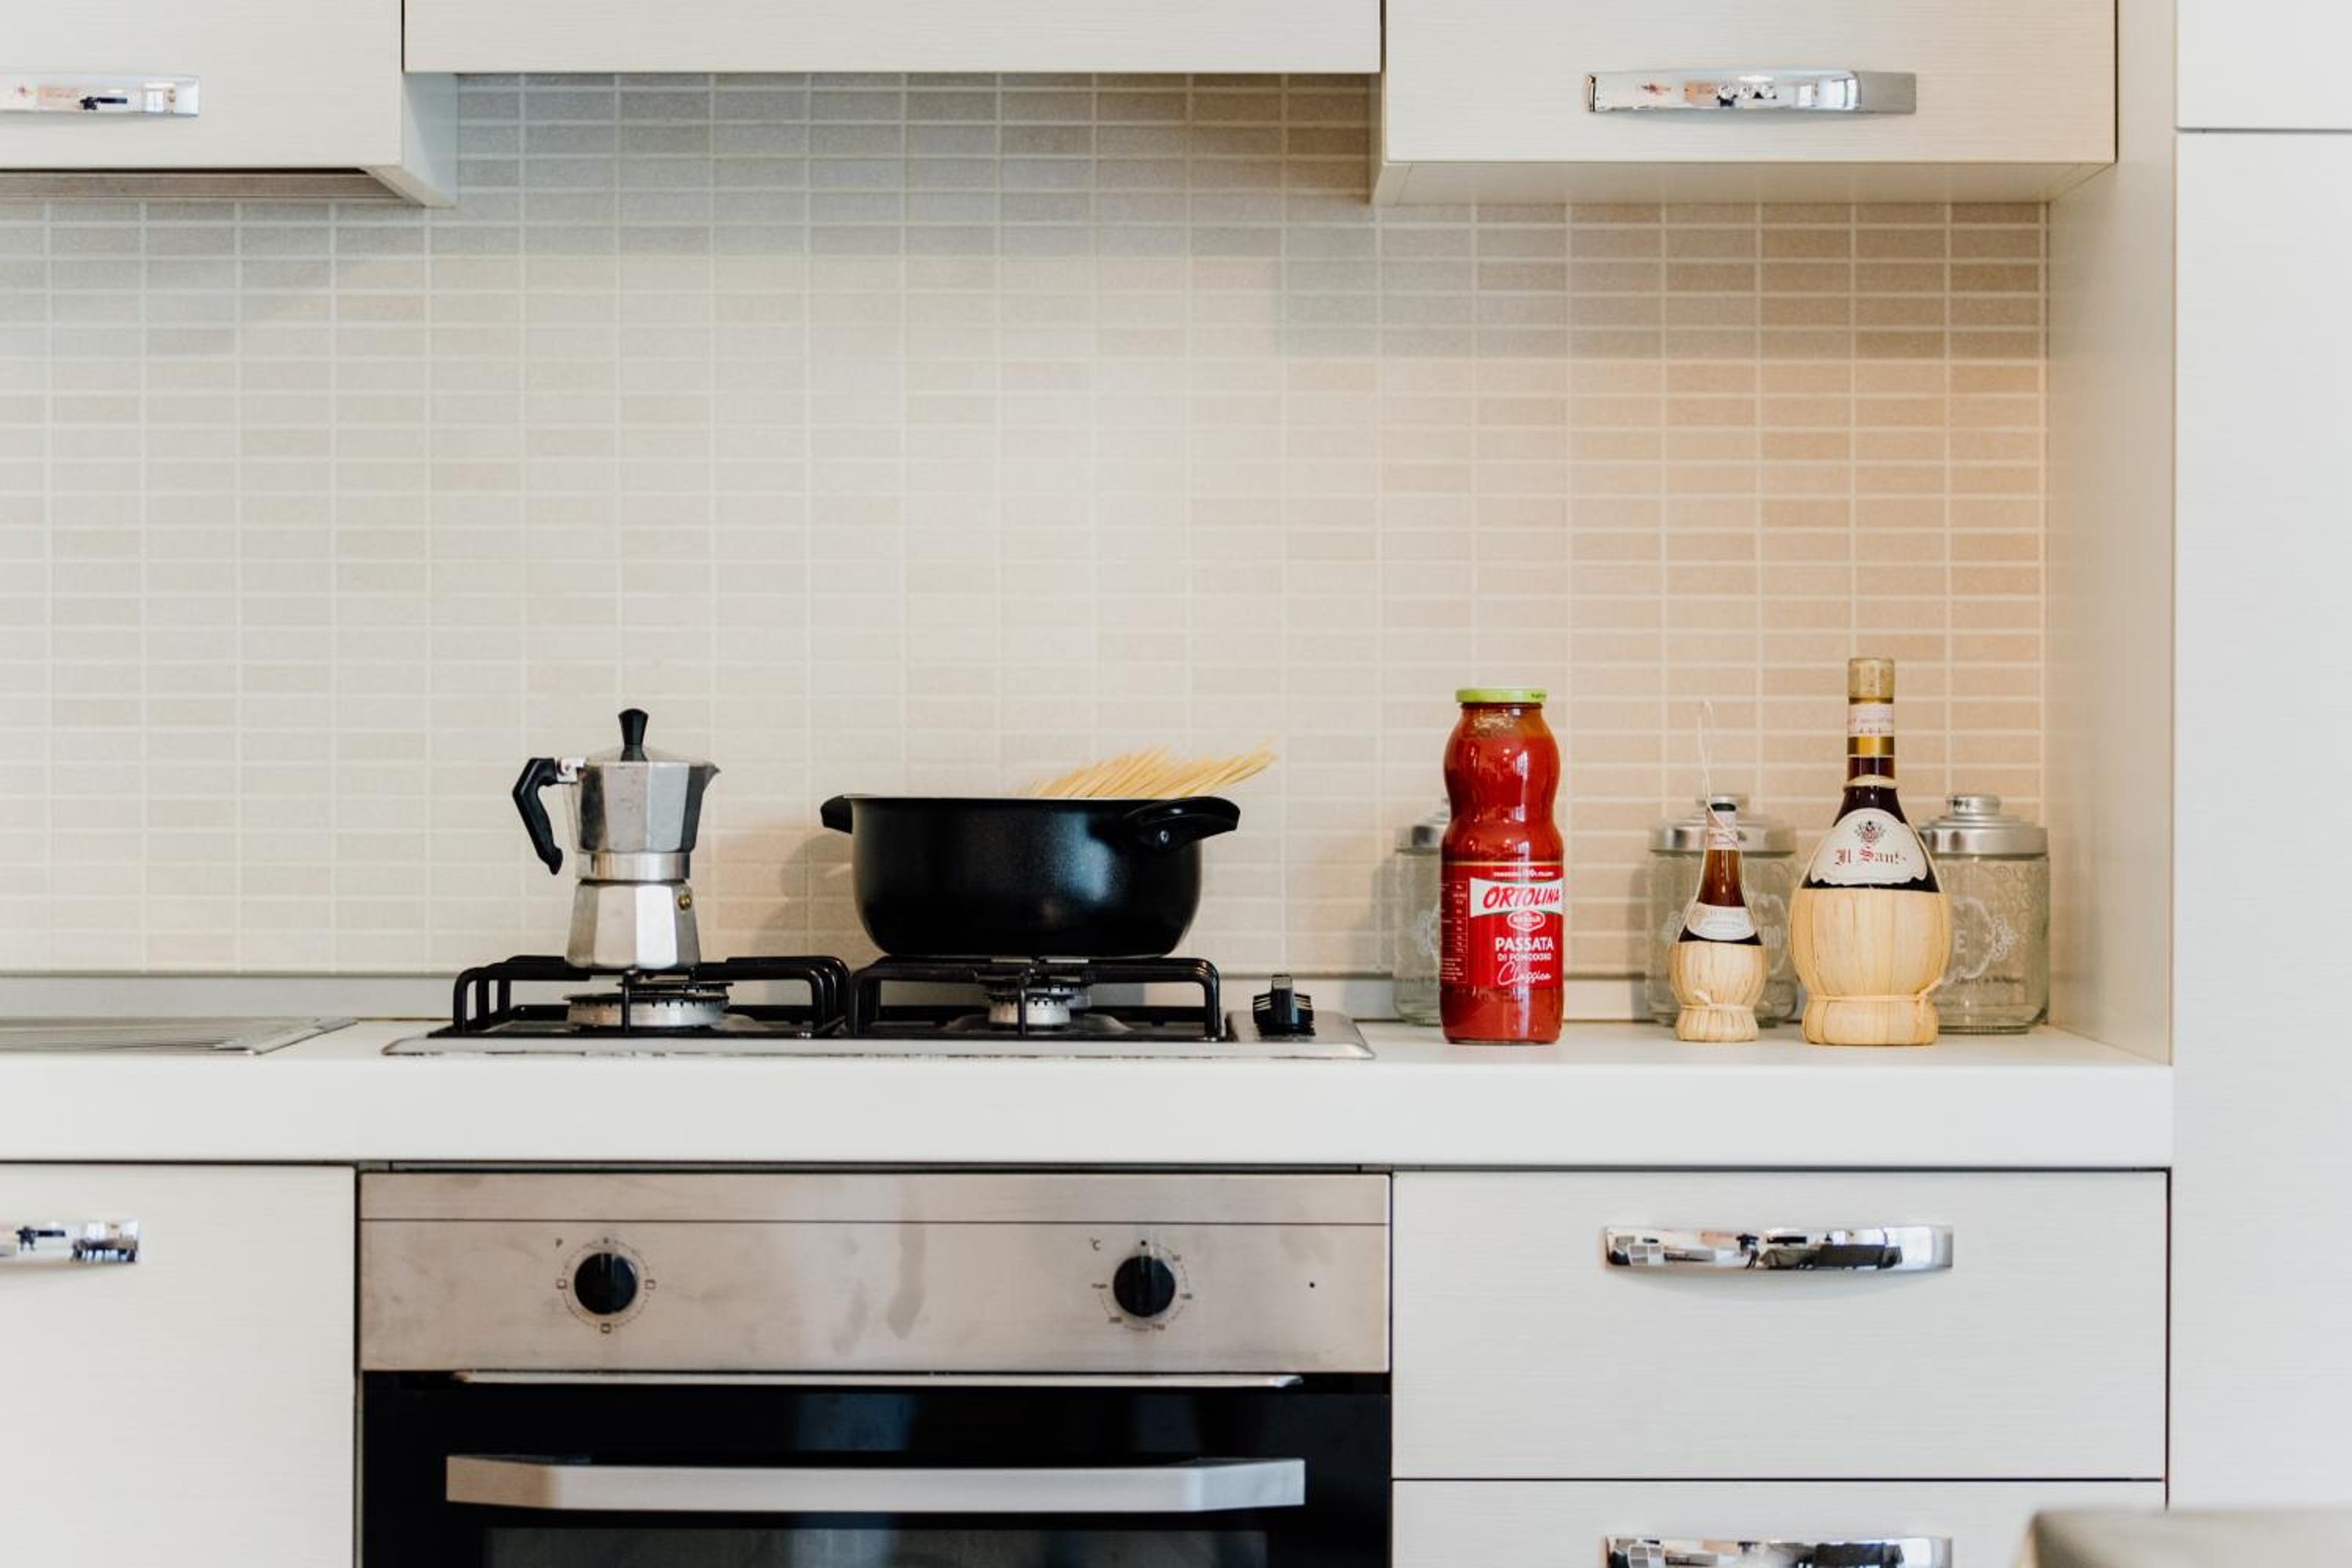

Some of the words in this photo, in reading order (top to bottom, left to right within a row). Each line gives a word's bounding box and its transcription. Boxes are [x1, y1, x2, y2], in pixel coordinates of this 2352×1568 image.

[1483, 885, 1560, 909] ORTOLINA
[1494, 937, 1555, 952] PASSATA
[1497, 953, 1507, 961] DI
